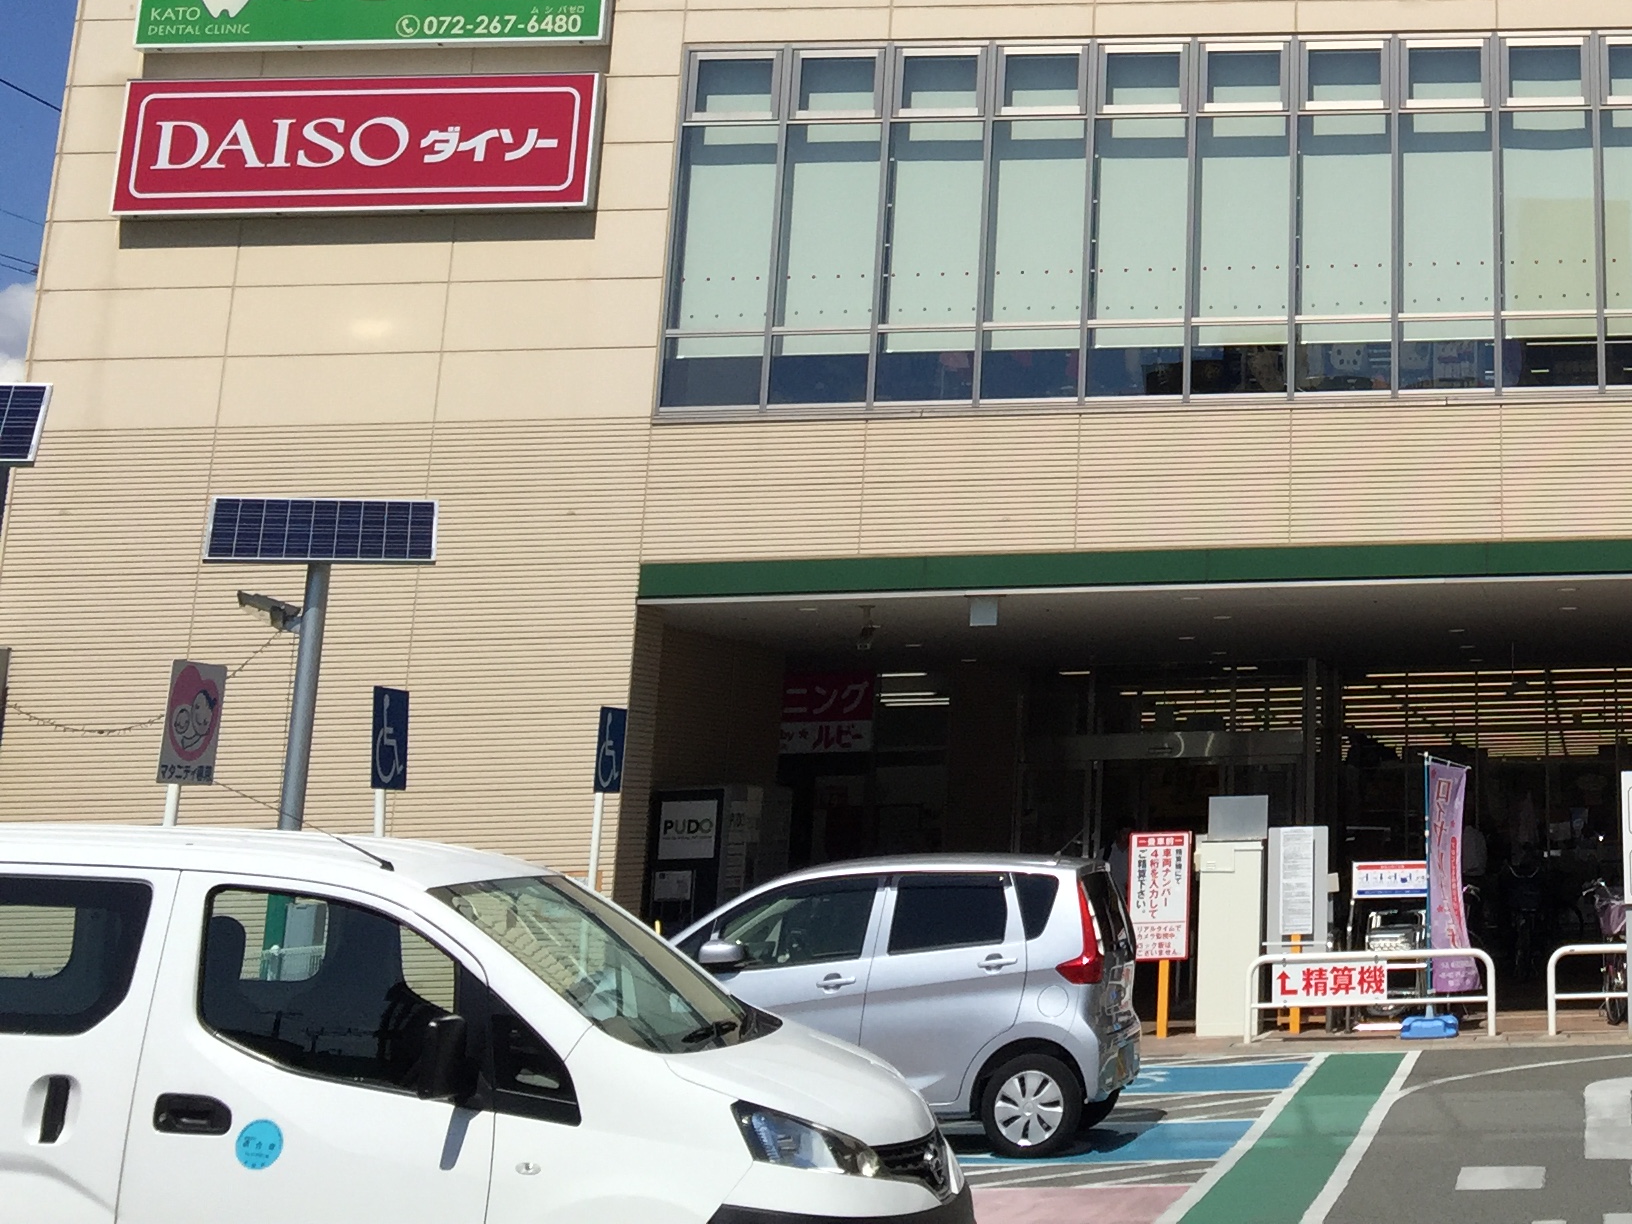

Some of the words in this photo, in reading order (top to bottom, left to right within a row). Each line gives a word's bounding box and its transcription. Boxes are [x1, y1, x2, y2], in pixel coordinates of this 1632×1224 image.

[150, 7, 200, 21] KATO
[147, 24, 200, 36] DENTAL
[204, 23, 251, 35] CLINIC
[422, 14, 582, 36] 072-267-6480
[150, 116, 410, 172] DAISO
[419, 126, 560, 164] ダイソー
[663, 817, 714, 835] PUDO
[1302, 965, 1385, 998] 精算機
